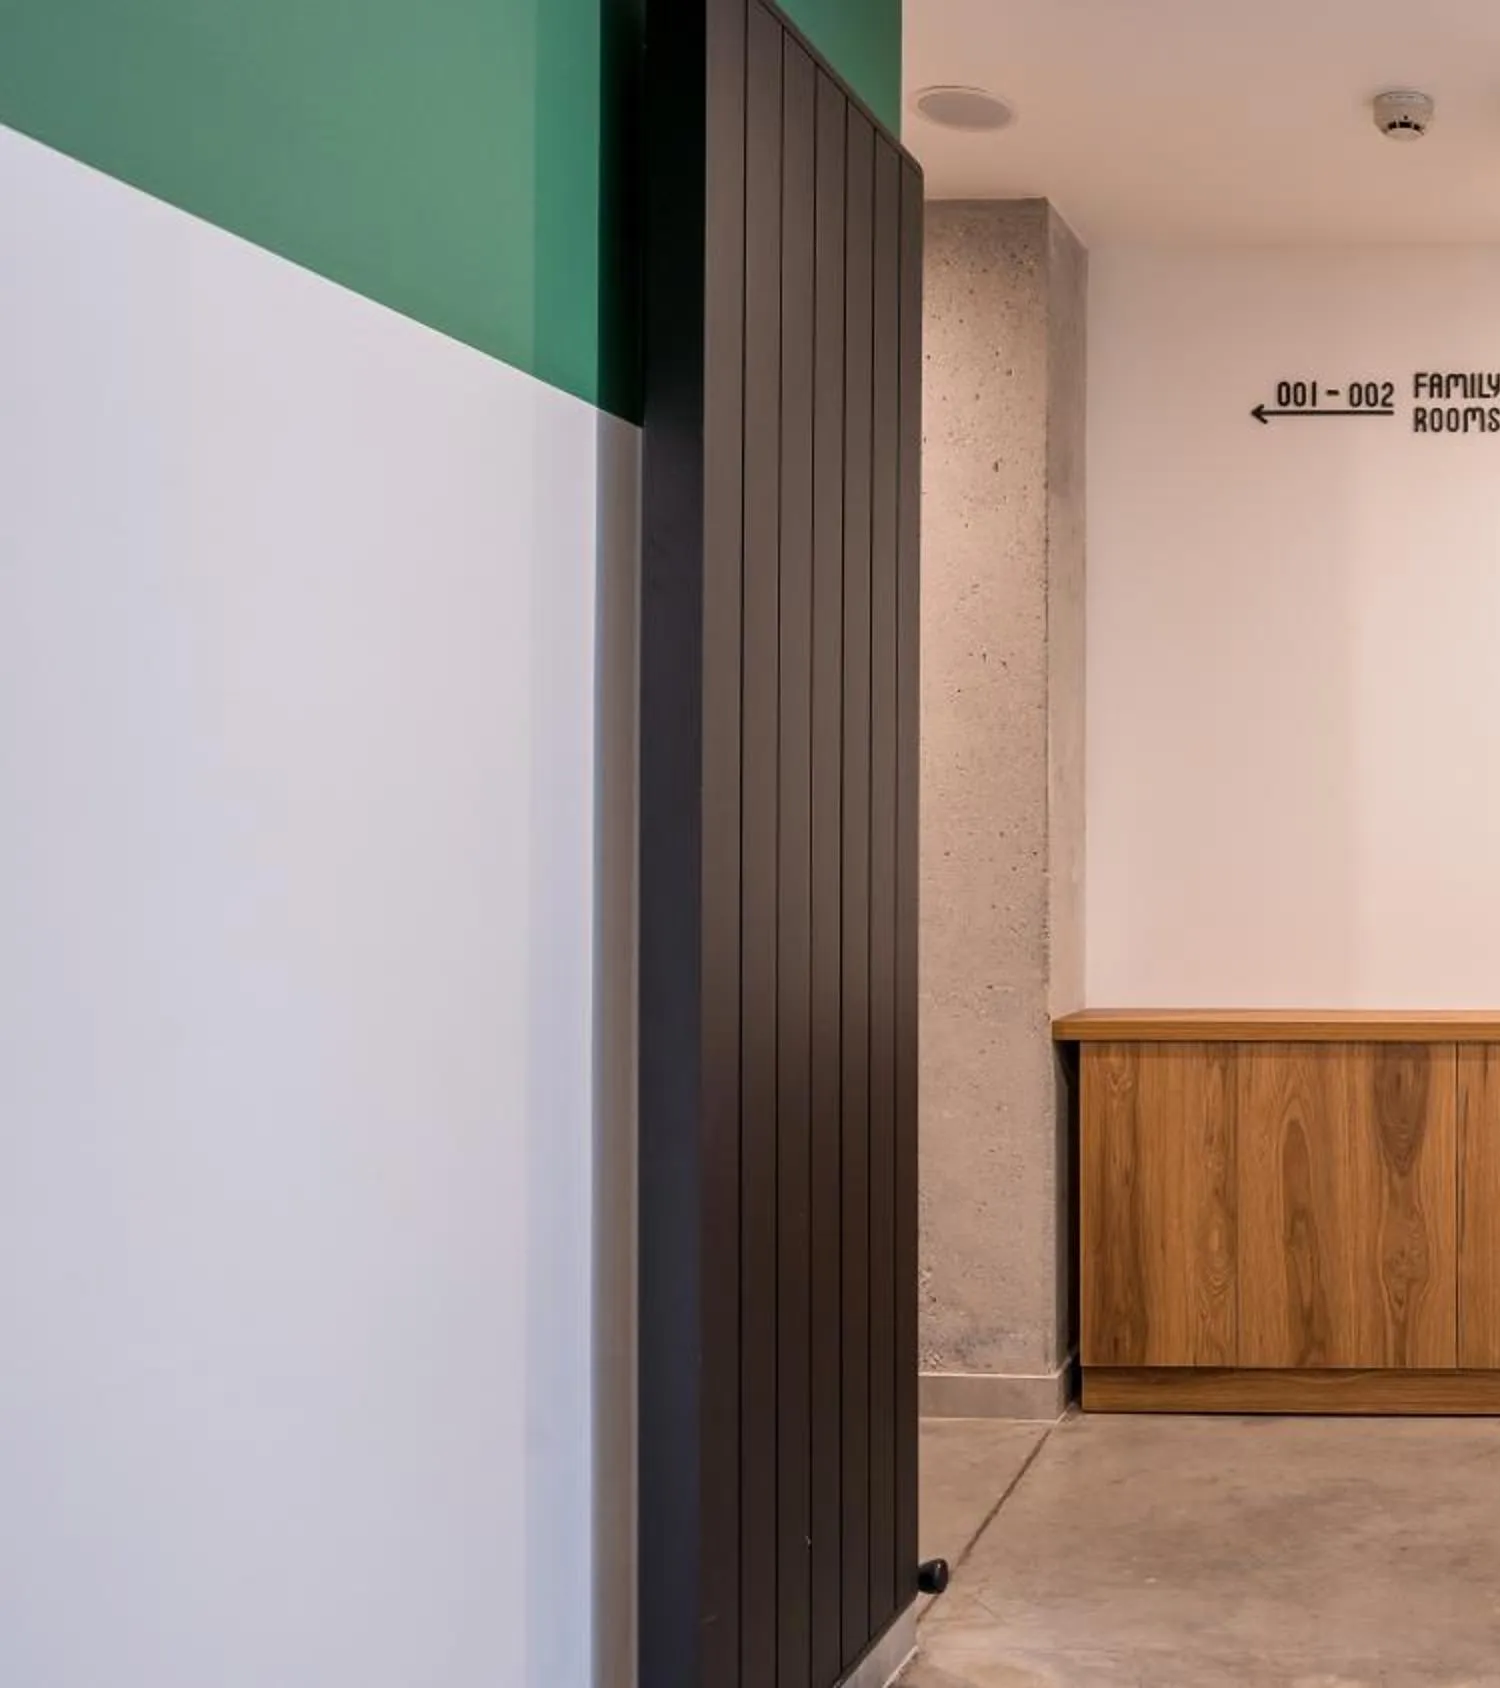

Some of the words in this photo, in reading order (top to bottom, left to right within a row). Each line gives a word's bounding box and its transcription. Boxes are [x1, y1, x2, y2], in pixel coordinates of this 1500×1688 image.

[1348, 381, 1395, 409] 002
[1413, 372, 1500, 399] FAMILY
[1413, 406, 1500, 433] ROOMS
